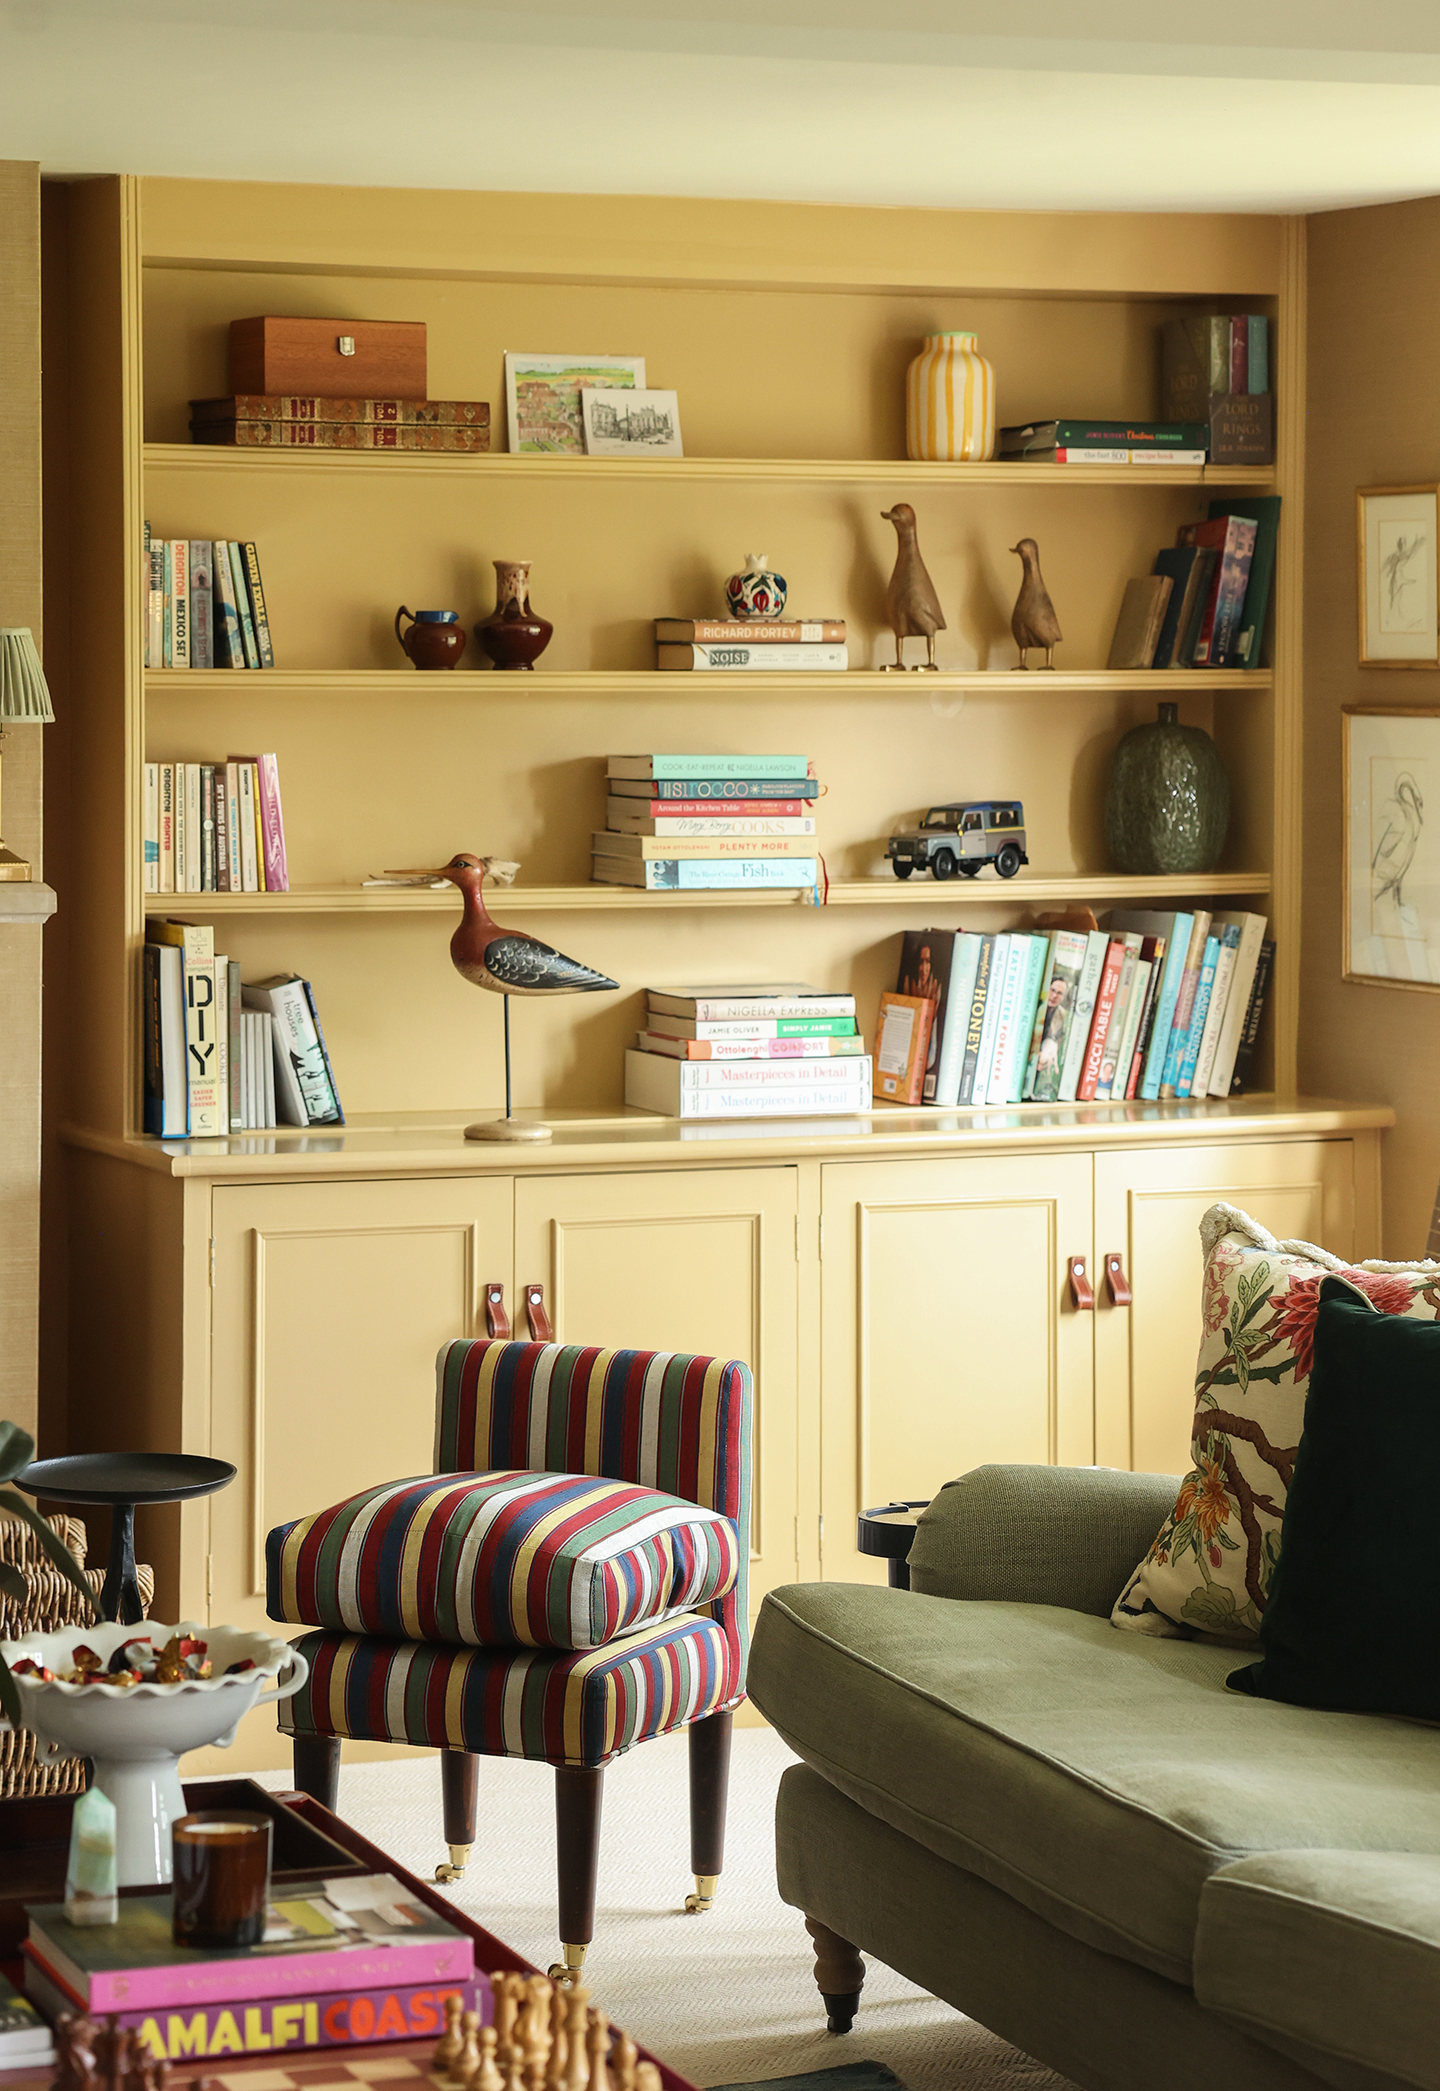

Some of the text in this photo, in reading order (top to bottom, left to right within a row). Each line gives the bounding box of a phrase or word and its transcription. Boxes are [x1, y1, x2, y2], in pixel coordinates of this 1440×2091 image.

[1225, 403, 1259, 415] LORD
[1223, 423, 1260, 435] RINGS
[1134, 452, 1154, 461] recipe
[1154, 451, 1174, 460] book
[176, 544, 185, 596] DEIGHTON
[245, 544, 260, 584] GAVIN
[252, 586, 266, 624] LYALL
[177, 599, 186, 637] MEXICO
[703, 627, 752, 638] RICHARD
[755, 627, 797, 638] FORTEY
[177, 640, 186, 657] SET
[710, 652, 749, 662] NOISE
[736, 764, 764, 772] NIGELLA
[766, 764, 796, 772] LAWSON
[163, 768, 171, 851] DEIGHTON FIGHTER
[217, 801, 225, 824] TOWNS
[657, 804, 682, 812] Around
[683, 804, 694, 812] the
[696, 803, 721, 812] Kitchen
[722, 804, 740, 812] Table
[217, 826, 226, 835] OF
[732, 821, 785, 833] COOKS
[218, 835, 227, 871] AUSTRALIA
[720, 843, 757, 851] PLENTY
[761, 842, 789, 851] MORE
[741, 863, 769, 877] Fish
[185, 956, 212, 965] Collins
[1030, 945, 1041, 968] COOK
[1083, 952, 1099, 993] gather
[1109, 972, 1119, 994] TUCCI
[966, 942, 991, 1054] spoonfuls of HONEY
[1163, 988, 1174, 1005] The
[1213, 969, 1229, 1016] PRUNING
[282, 1001, 299, 1038] houses
[294, 1002, 305, 1025] tree
[727, 1006, 828, 1016] NIGELLA EXPRESS
[994, 949, 1019, 1081] EAT BETTER FOREVER
[1158, 1005, 1170, 1037] Kitchen
[188, 975, 214, 1076] DIY
[217, 977, 228, 1085] Ultimate COOKER
[809, 1024, 833, 1032] JAMIE
[947, 977, 967, 1084] NIGELLA LAWSON
[1187, 984, 1212, 1064] GARDENING
[716, 1042, 825, 1056] Ottolenghi COMFORT
[1086, 1041, 1102, 1084] TUCCI
[1095, 999, 1111, 1041] TABLE
[1122, 1045, 1131, 1063] BOOK
[1149, 1037, 1163, 1077] Gardener
[1200, 1028, 1217, 1079] TRAINING
[188, 1077, 215, 1085] manual
[721, 1068, 795, 1083] Masterpieces
[798, 1068, 810, 1078] in
[813, 1066, 847, 1078] Detail
[721, 1093, 795, 1108] Masterpieces
[798, 1092, 810, 1104] in
[813, 1092, 847, 1104] Detail
[139, 2001, 319, 2061] AMALFI
[323, 1988, 463, 2041] COAST
